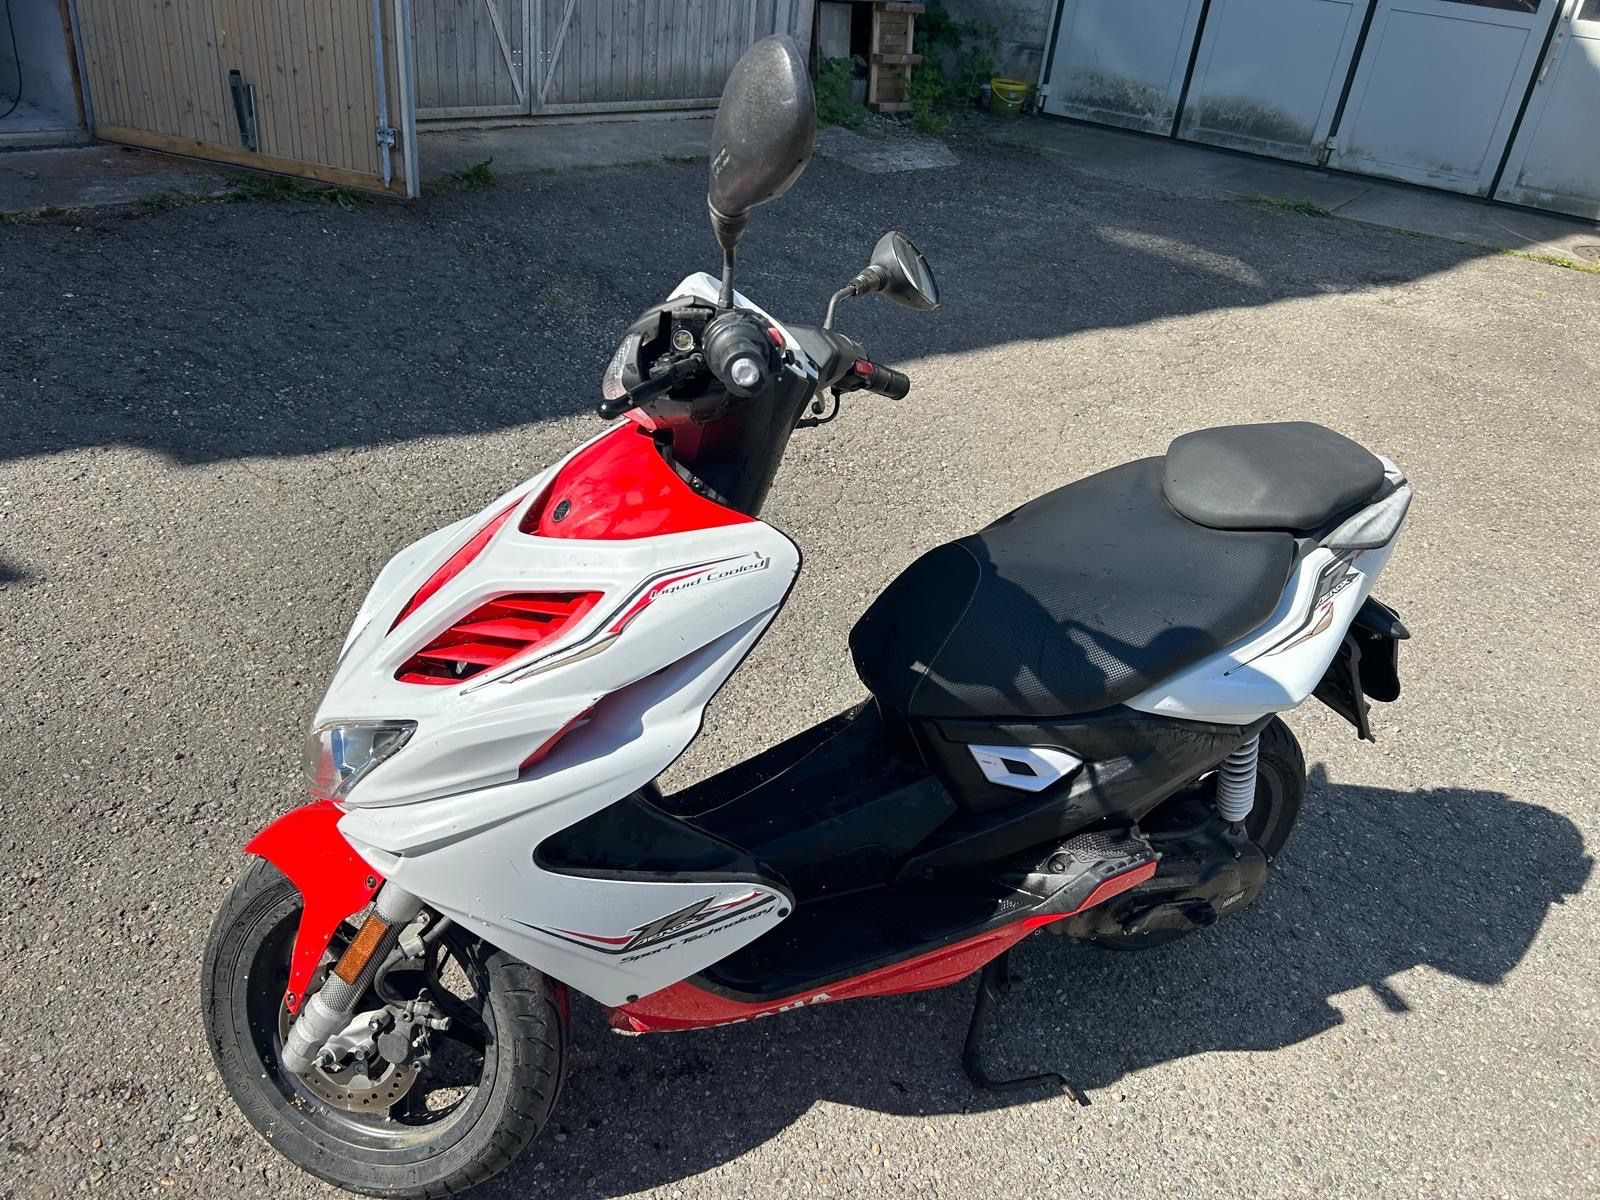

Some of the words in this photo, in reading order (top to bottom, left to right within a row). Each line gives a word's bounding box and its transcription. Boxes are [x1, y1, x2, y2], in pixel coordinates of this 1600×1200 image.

[650, 577, 702, 598] Liquid
[706, 559, 766, 581] Cooled
[617, 942, 677, 965] Sport
[680, 905, 776, 946] Technology
